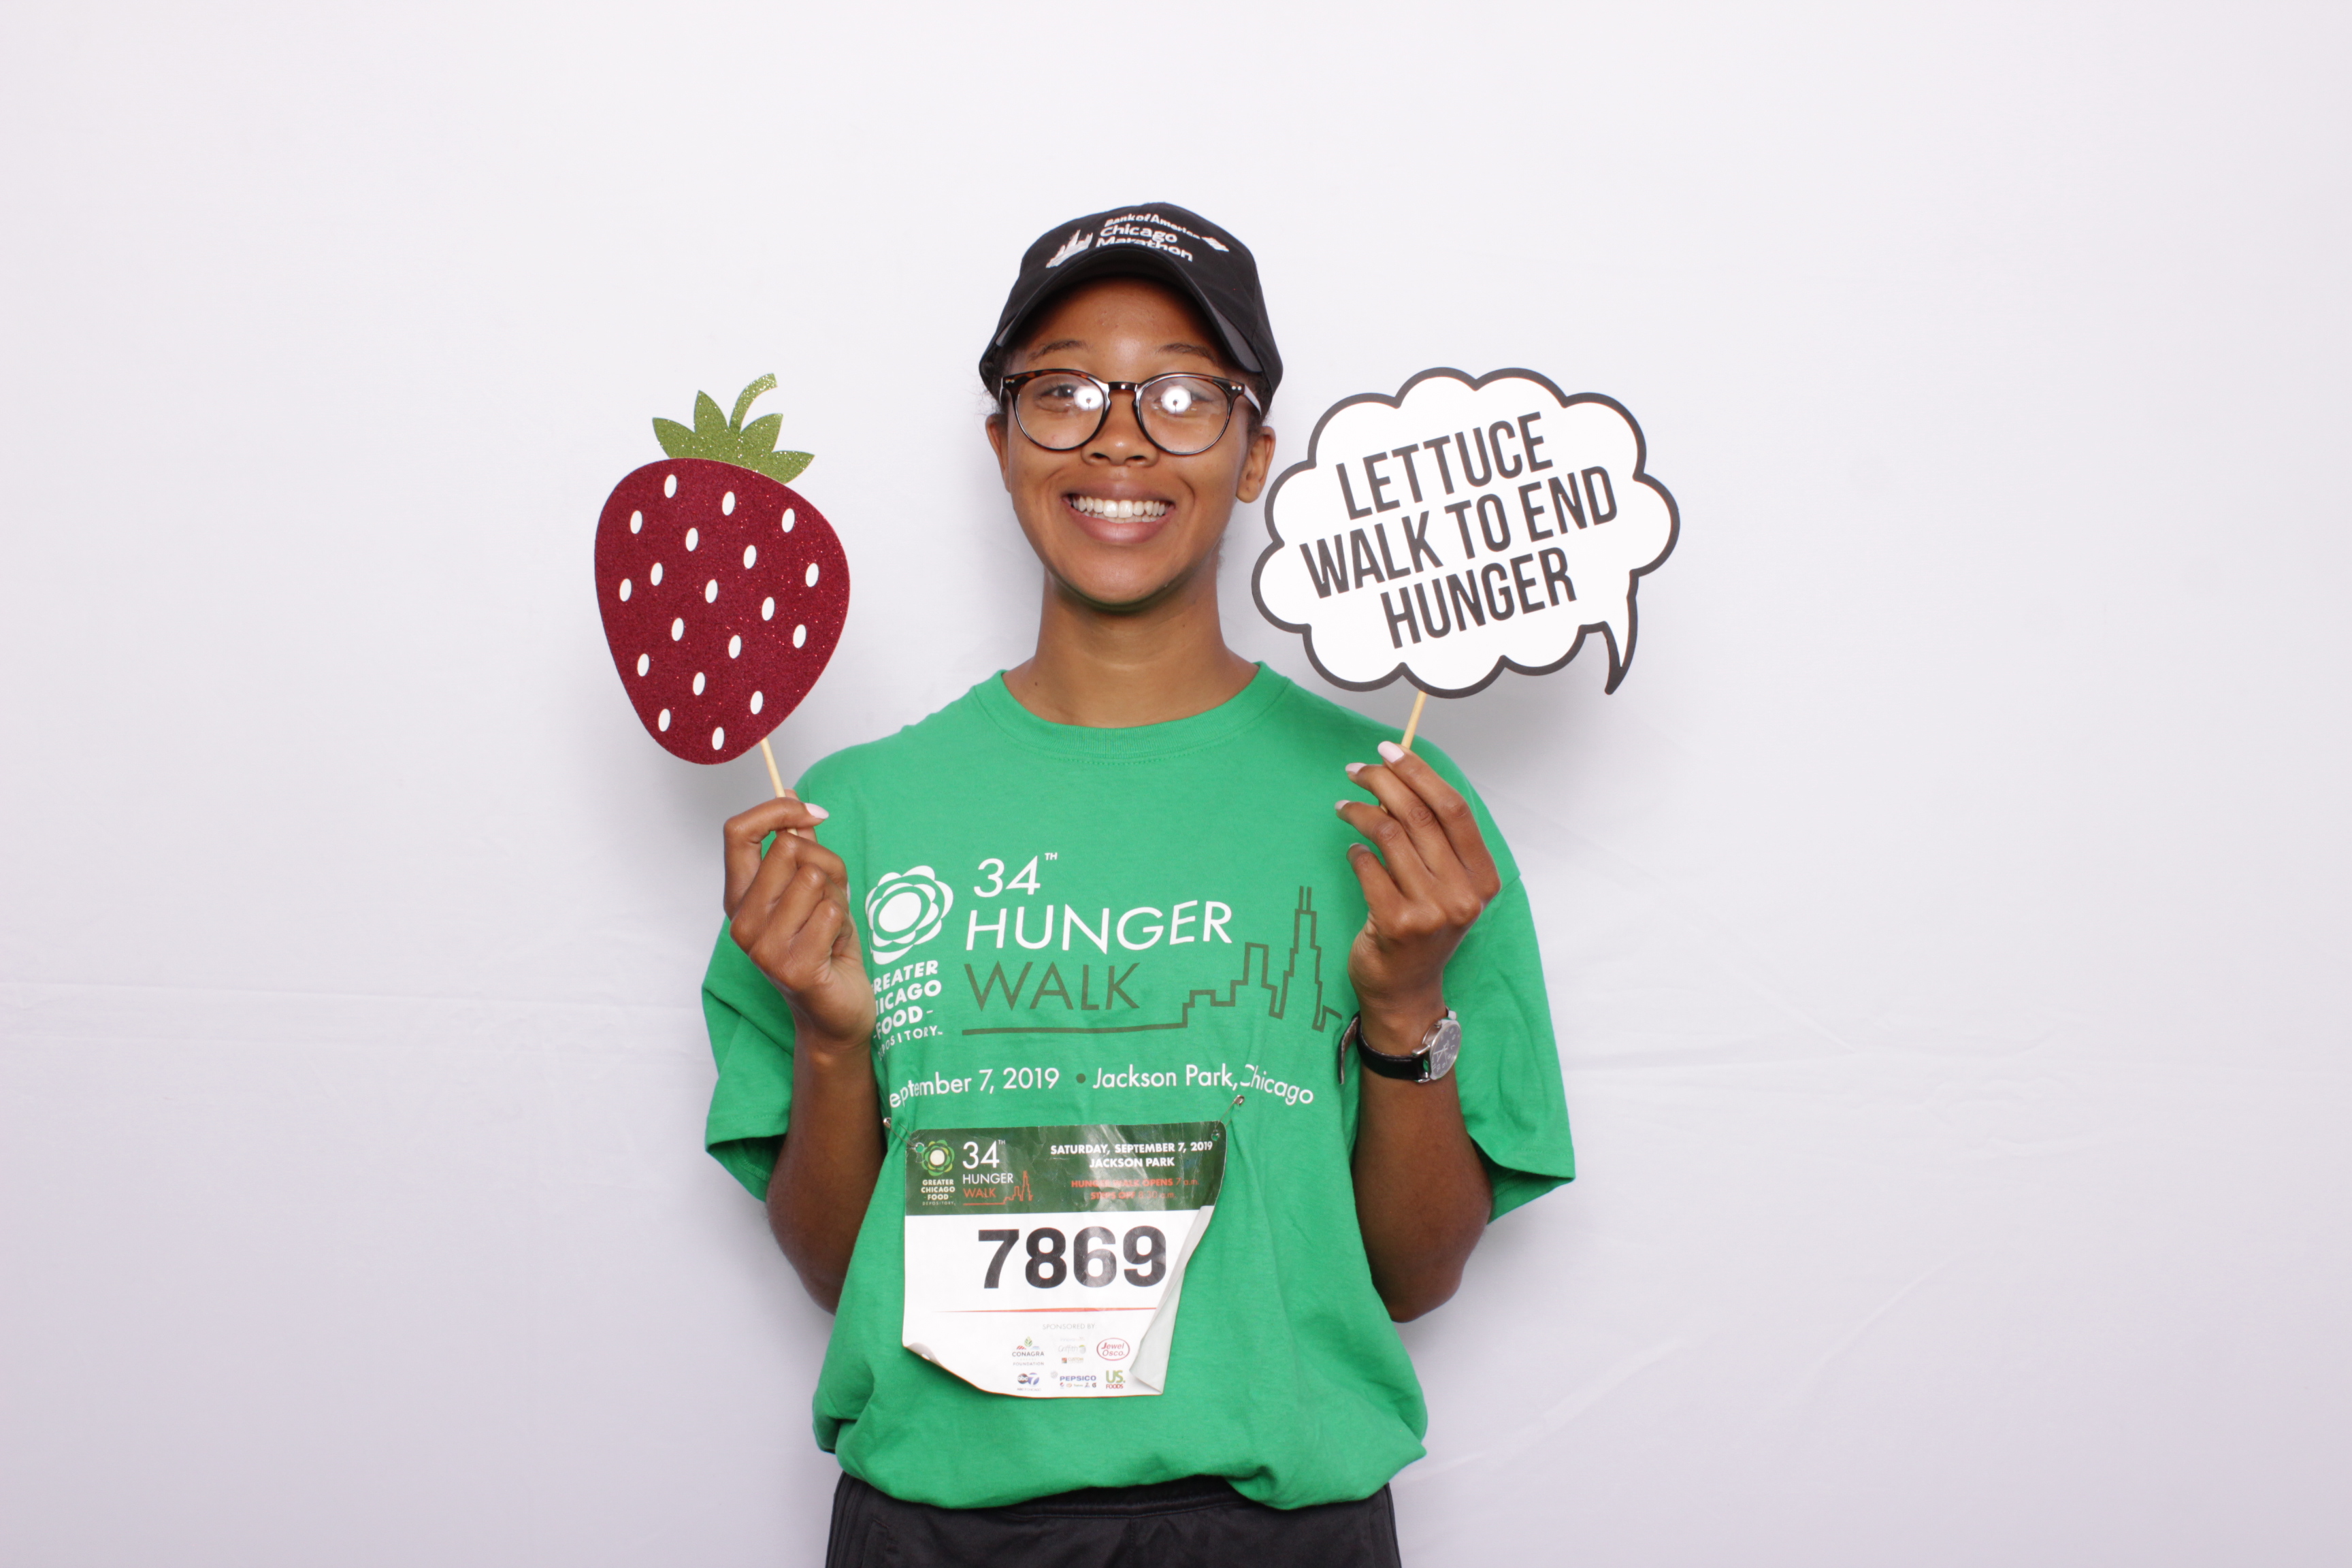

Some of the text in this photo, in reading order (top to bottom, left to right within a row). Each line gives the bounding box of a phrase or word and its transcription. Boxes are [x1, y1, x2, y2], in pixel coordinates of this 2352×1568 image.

[1100, 224, 1177, 243] Chicago
[1105, 214, 1135, 227] Bank
[1150, 214, 1200, 240] America
[1096, 236, 1193, 262] Marathon
[1336, 411, 1553, 520] LETTUCE
[1299, 466, 1617, 599] WALK TO END
[1380, 546, 1577, 649] HUNGER
[966, 900, 1232, 955] HUNGER
[872, 960, 938, 994] REATER
[964, 960, 1141, 1012] WALK
[889, 1071, 972, 1108] eptember
[979, 1069, 994, 1094] 7,
[1003, 1067, 1060, 1089] 2019
[1092, 1064, 1177, 1089] Jackson
[1186, 1063, 1237, 1091] Park,
[1050, 1141, 1213, 1155] SATURDAY, SEPTEMBER 7, 2019
[1089, 1157, 1175, 1169] JACKSON PARK
[963, 1173, 1014, 1184] HUNGER
[963, 1188, 996, 1198] WALK
[1071, 1179, 1109, 1188] HUNGER
[1142, 1178, 1173, 1186] OPENS
[978, 1225, 1166, 1289] 7869
